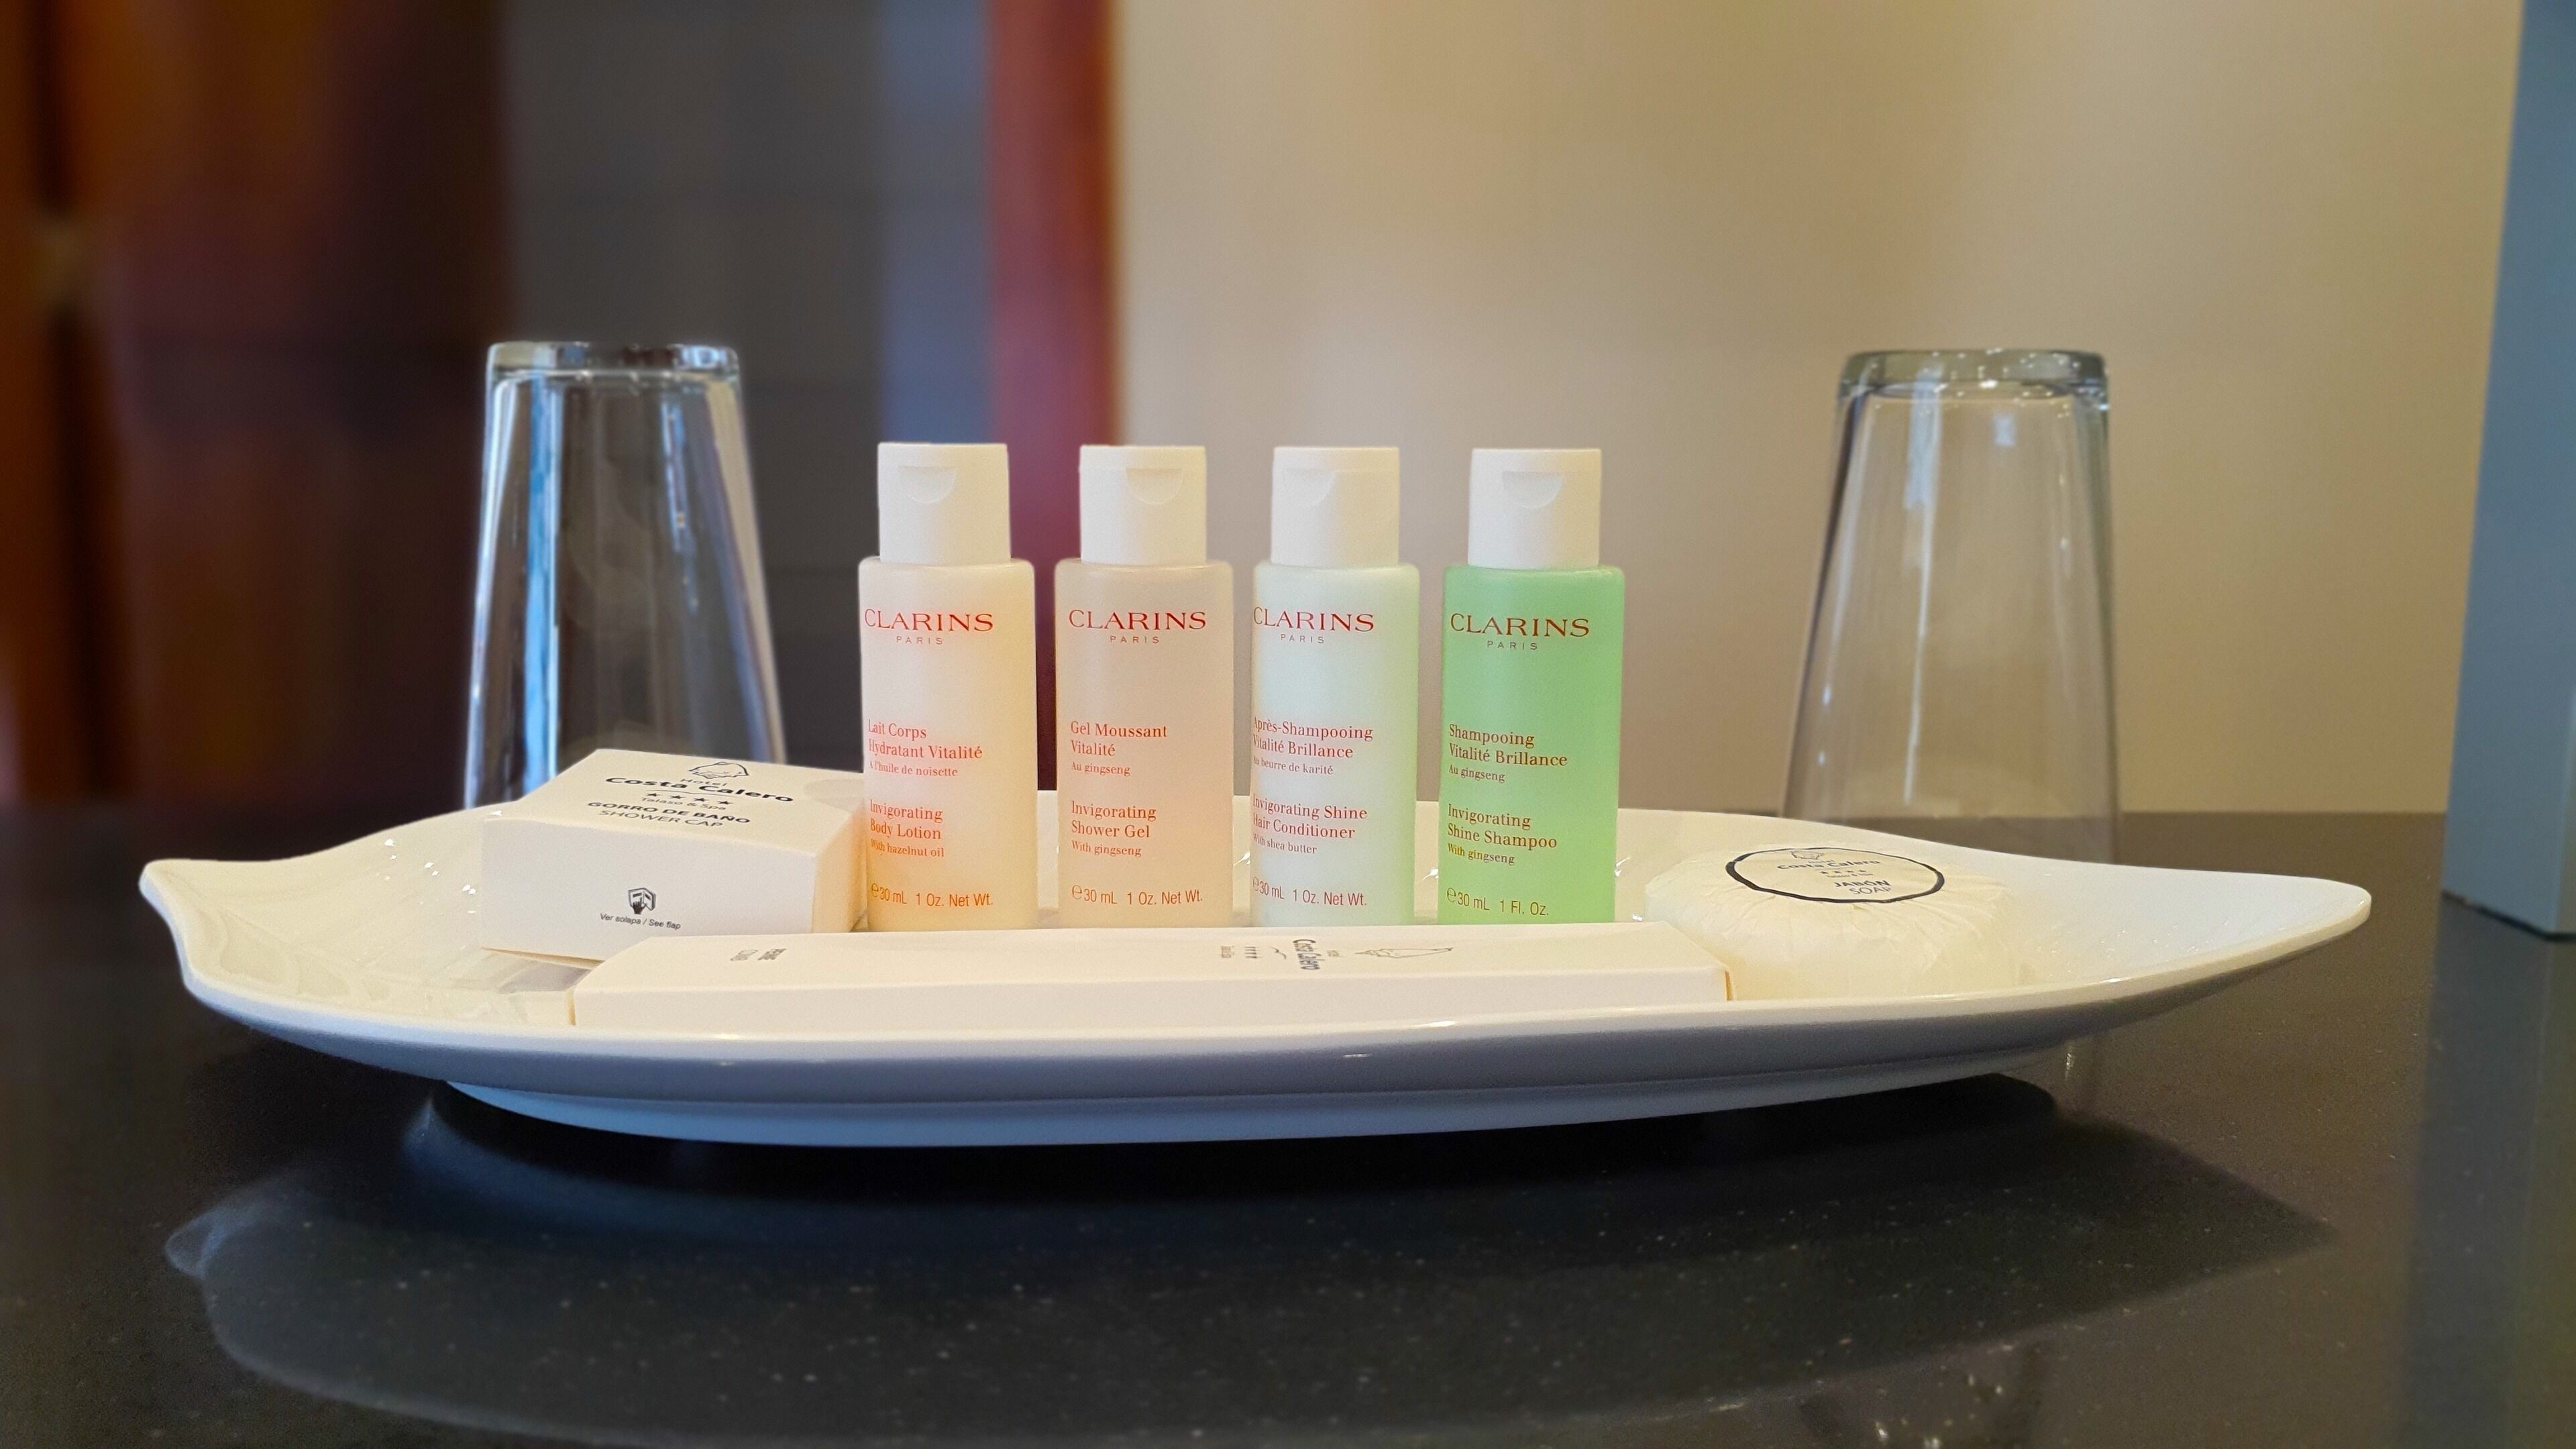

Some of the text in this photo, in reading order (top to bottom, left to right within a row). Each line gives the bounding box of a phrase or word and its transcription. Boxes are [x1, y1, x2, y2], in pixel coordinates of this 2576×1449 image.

[865, 608, 994, 632] CLARINS
[1069, 609, 1206, 630] CLARINS
[1254, 606, 1374, 632] CLARINS
[1451, 613, 1589, 637] CLARINS
[896, 636, 943, 645] PARIS
[1281, 634, 1324, 643] PARIS
[1487, 641, 1538, 650] PARIS
[868, 719, 926, 741] Lait Corps
[1071, 720, 1167, 737] Gel Moussant
[1254, 717, 1373, 742] Après-Shampooing
[1450, 724, 1534, 749] Shampooing
[869, 739, 983, 759] Hydratant Vitalité
[1071, 740, 1116, 756] Vitalité
[1253, 734, 1353, 758] Vitalité Brillance
[1450, 743, 1567, 766] Vitalité Brillance
[902, 765, 913, 775] de
[916, 767, 958, 776] noisette
[1072, 761, 1130, 776] Au gingseng
[1261, 757, 1286, 770] beurre
[1289, 763, 1299, 772] de
[1303, 763, 1334, 775] karité
[1449, 765, 1505, 784] Au gingseng
[606, 777, 794, 802] Costa Calero
[681, 778, 727, 787] Hotel
[588, 802, 657, 812] GORRO
[694, 812, 751, 824] BAÑO
[870, 799, 943, 823] Invigorating
[1072, 800, 1157, 822] Invigorating
[1253, 794, 1367, 820] Invigorating Shine
[1448, 804, 1531, 830] Invigorating
[599, 810, 723, 827] SHOWER CAP
[871, 818, 941, 839] Body Lotion
[1253, 813, 1355, 839] Hair Conditioner
[1072, 820, 1150, 838] Shower Gel
[1448, 823, 1557, 851] Shine Shampoo
[888, 843, 928, 856] hazelnut
[931, 848, 945, 857] oil
[1071, 840, 1141, 857] With gingseng
[1267, 839, 1285, 850] shea
[1288, 842, 1317, 854] butter
[1448, 843, 1515, 865] With gingseng
[893, 891, 907, 904] mL
[916, 893, 920, 905] 1
[927, 894, 944, 906] Oz.
[949, 894, 969, 907] Net
[973, 893, 993, 906] Wt.
[1101, 892, 1118, 904] mL
[1127, 892, 1132, 905] 1
[1139, 892, 1157, 905] Oz.
[1162, 892, 1181, 905] Net
[1185, 890, 1202, 902] Wt.
[1272, 886, 1284, 899] mL
[1293, 889, 1297, 902] 1
[1303, 890, 1320, 904] Oz.
[1324, 892, 1343, 906] Net
[1348, 893, 1367, 906] Wt.
[1473, 898, 1490, 910] mL
[1499, 900, 1504, 912] 1
[1511, 901, 1524, 914] Fl.
[1530, 902, 1549, 916] Oz.
[615, 916, 641, 924] solapa
[667, 921, 681, 930] flap
